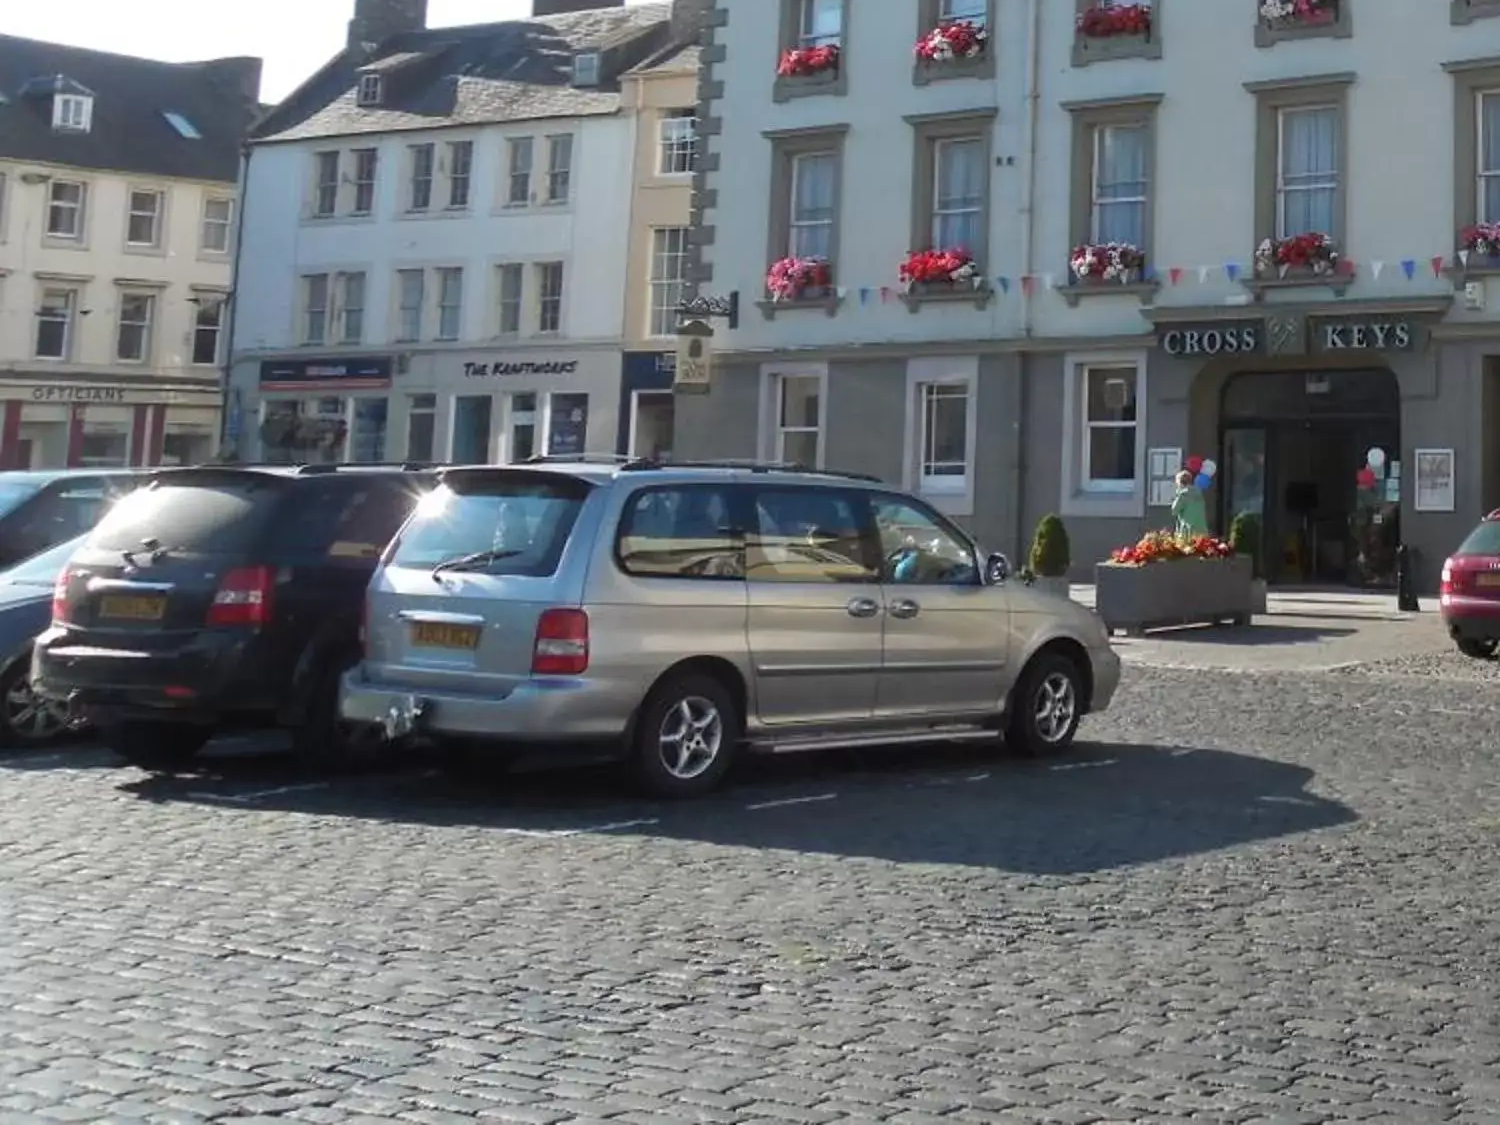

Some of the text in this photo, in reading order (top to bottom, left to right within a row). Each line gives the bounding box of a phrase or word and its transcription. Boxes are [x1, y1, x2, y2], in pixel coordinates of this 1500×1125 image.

[1163, 322, 1409, 355] CROSS KEYS
[463, 361, 488, 376] THE
[33, 386, 126, 402] OPTICIANS
